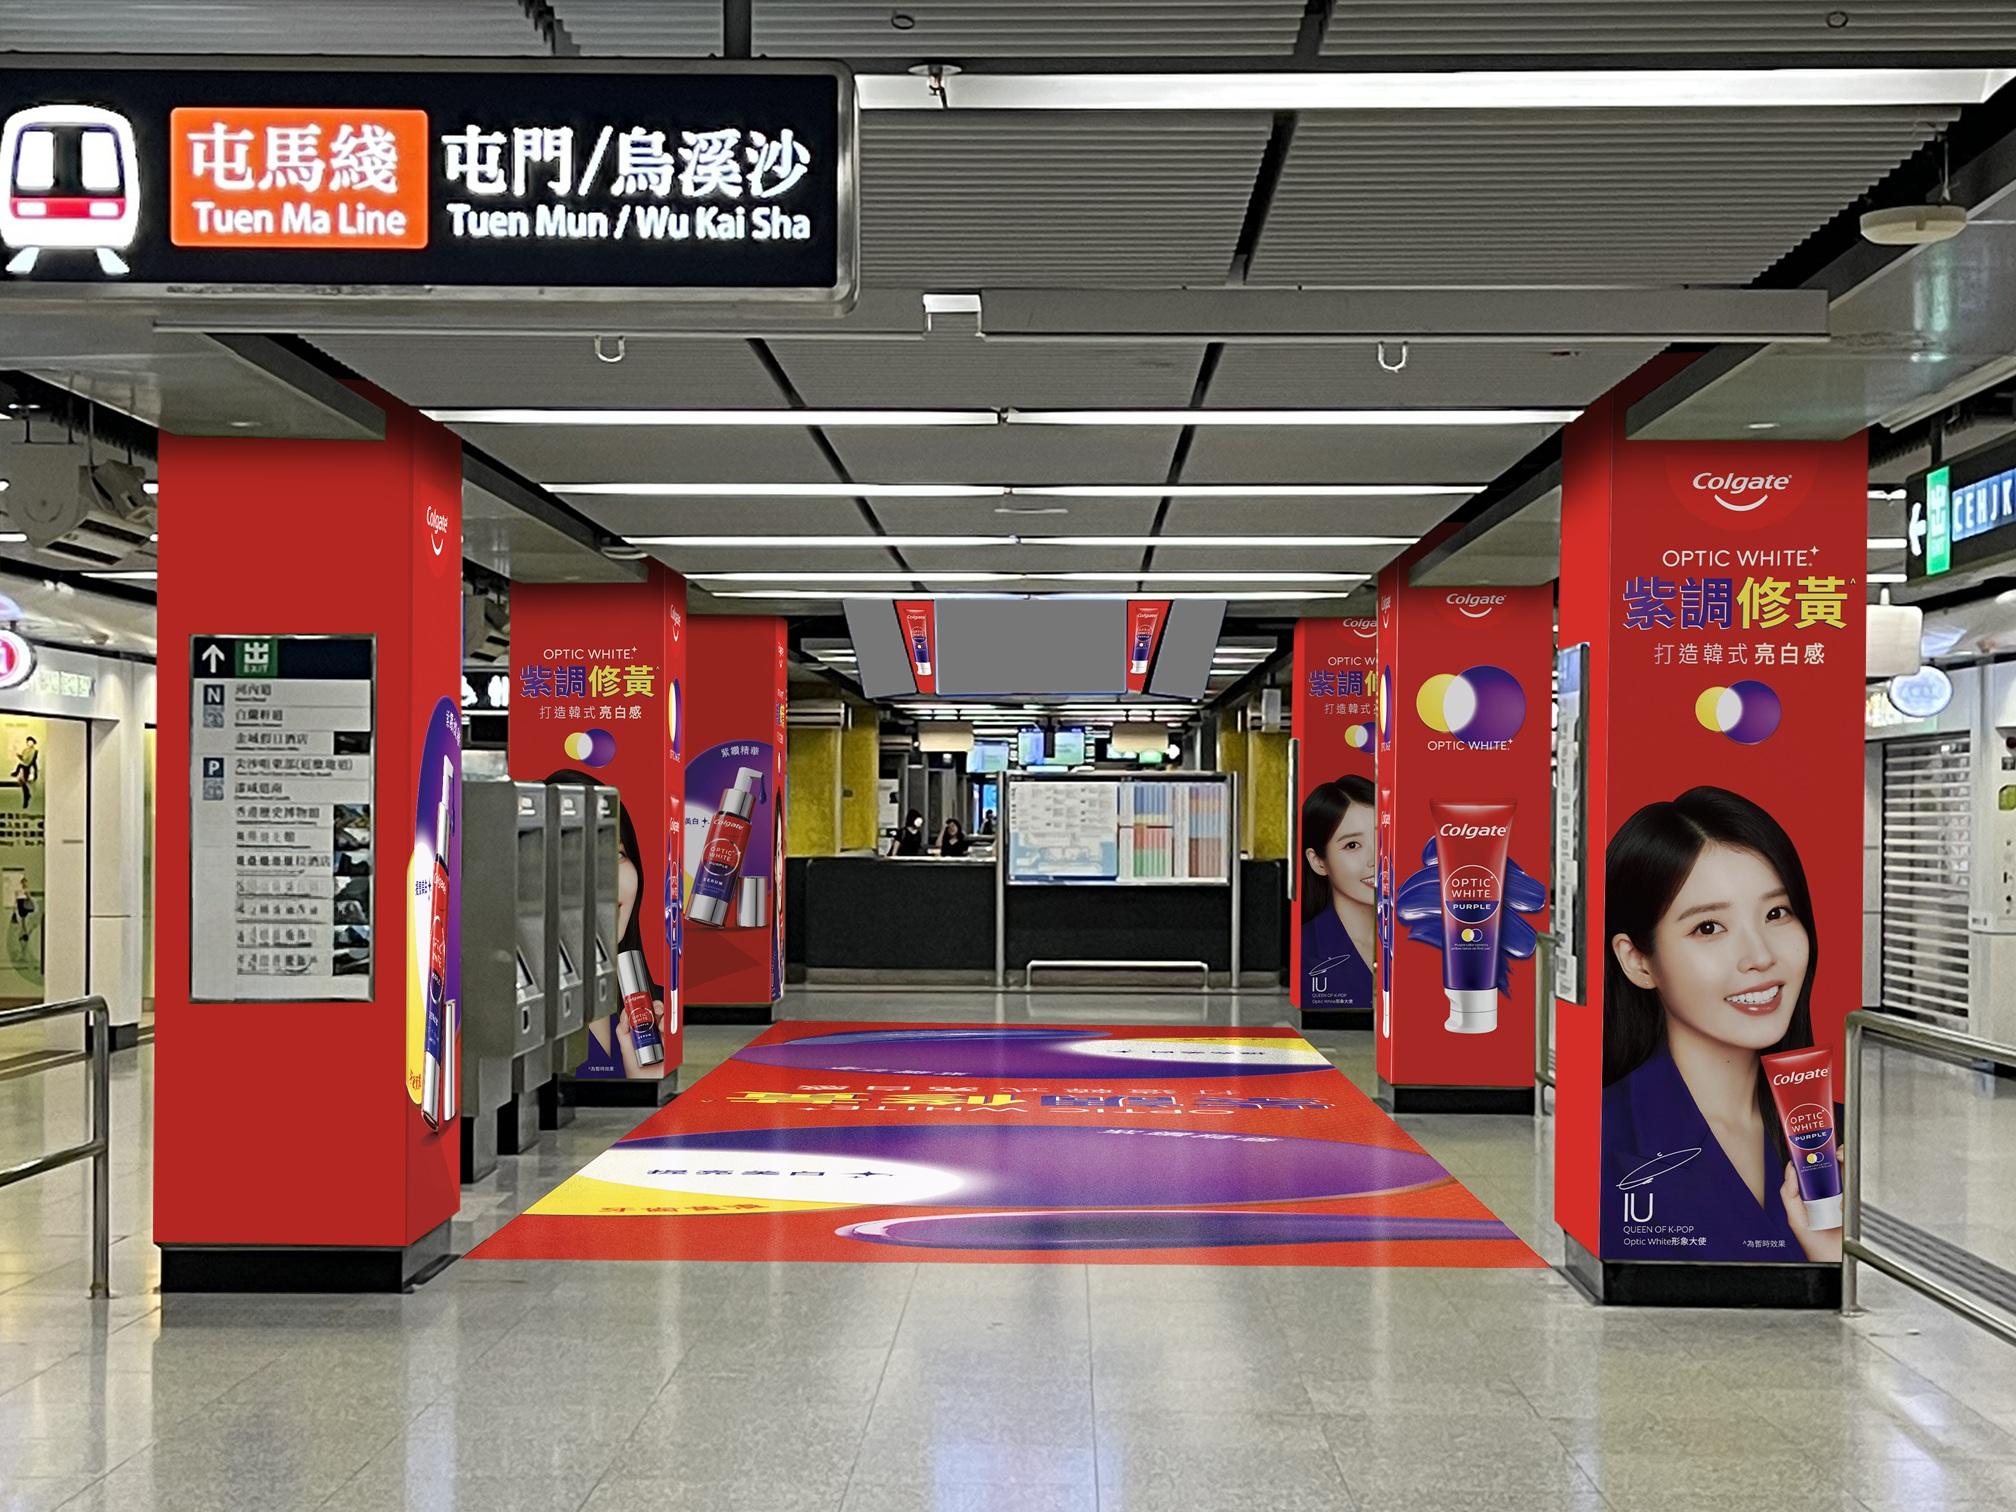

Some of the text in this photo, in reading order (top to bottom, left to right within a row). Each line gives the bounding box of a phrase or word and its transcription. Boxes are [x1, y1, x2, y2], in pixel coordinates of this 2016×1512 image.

[441, 124, 811, 198] 屯門/烏溪沙
[192, 201, 408, 236] Tuen Ma Line
[446, 203, 529, 238] Tuen
[535, 205, 608, 239] Mun
[635, 205, 690, 239] Wu
[695, 206, 746, 239] Kai
[752, 206, 811, 239] Sha
[1692, 472, 1792, 494] Colgate
[426, 505, 448, 534] Colgate
[1662, 550, 1808, 567] OPTIC WHITE
[1446, 593, 1506, 607] Colgate
[244, 642, 269, 664] 出
[543, 649, 632, 660] OPTIC WHITE
[1654, 642, 1825, 665] 打造韓式亮白感
[244, 664, 268, 673] EXIT
[1328, 656, 1362, 666] OPTIC
[207, 688, 220, 703] N
[539, 705, 642, 719] 打造韓式亮白感
[1427, 740, 1507, 751] OPTIC WHITE
[208, 761, 220, 776] P
[713, 816, 744, 830] Colgate
[1440, 823, 1508, 839] Colgate
[1451, 878, 1492, 889] OPTIC
[1452, 889, 1492, 898] WHITE
[1312, 976, 1327, 993] IU
[1773, 1066, 1830, 1087] Colgate
[1790, 1110, 1824, 1125] OPTIC
[1792, 1120, 1825, 1133] WHITE
[1795, 1131, 1828, 1142] PURPLE
[1623, 1192, 1654, 1223] IU
[1623, 1225, 1694, 1234] QUEEN OF K-POP
[1624, 1237, 1645, 1247] Optic
